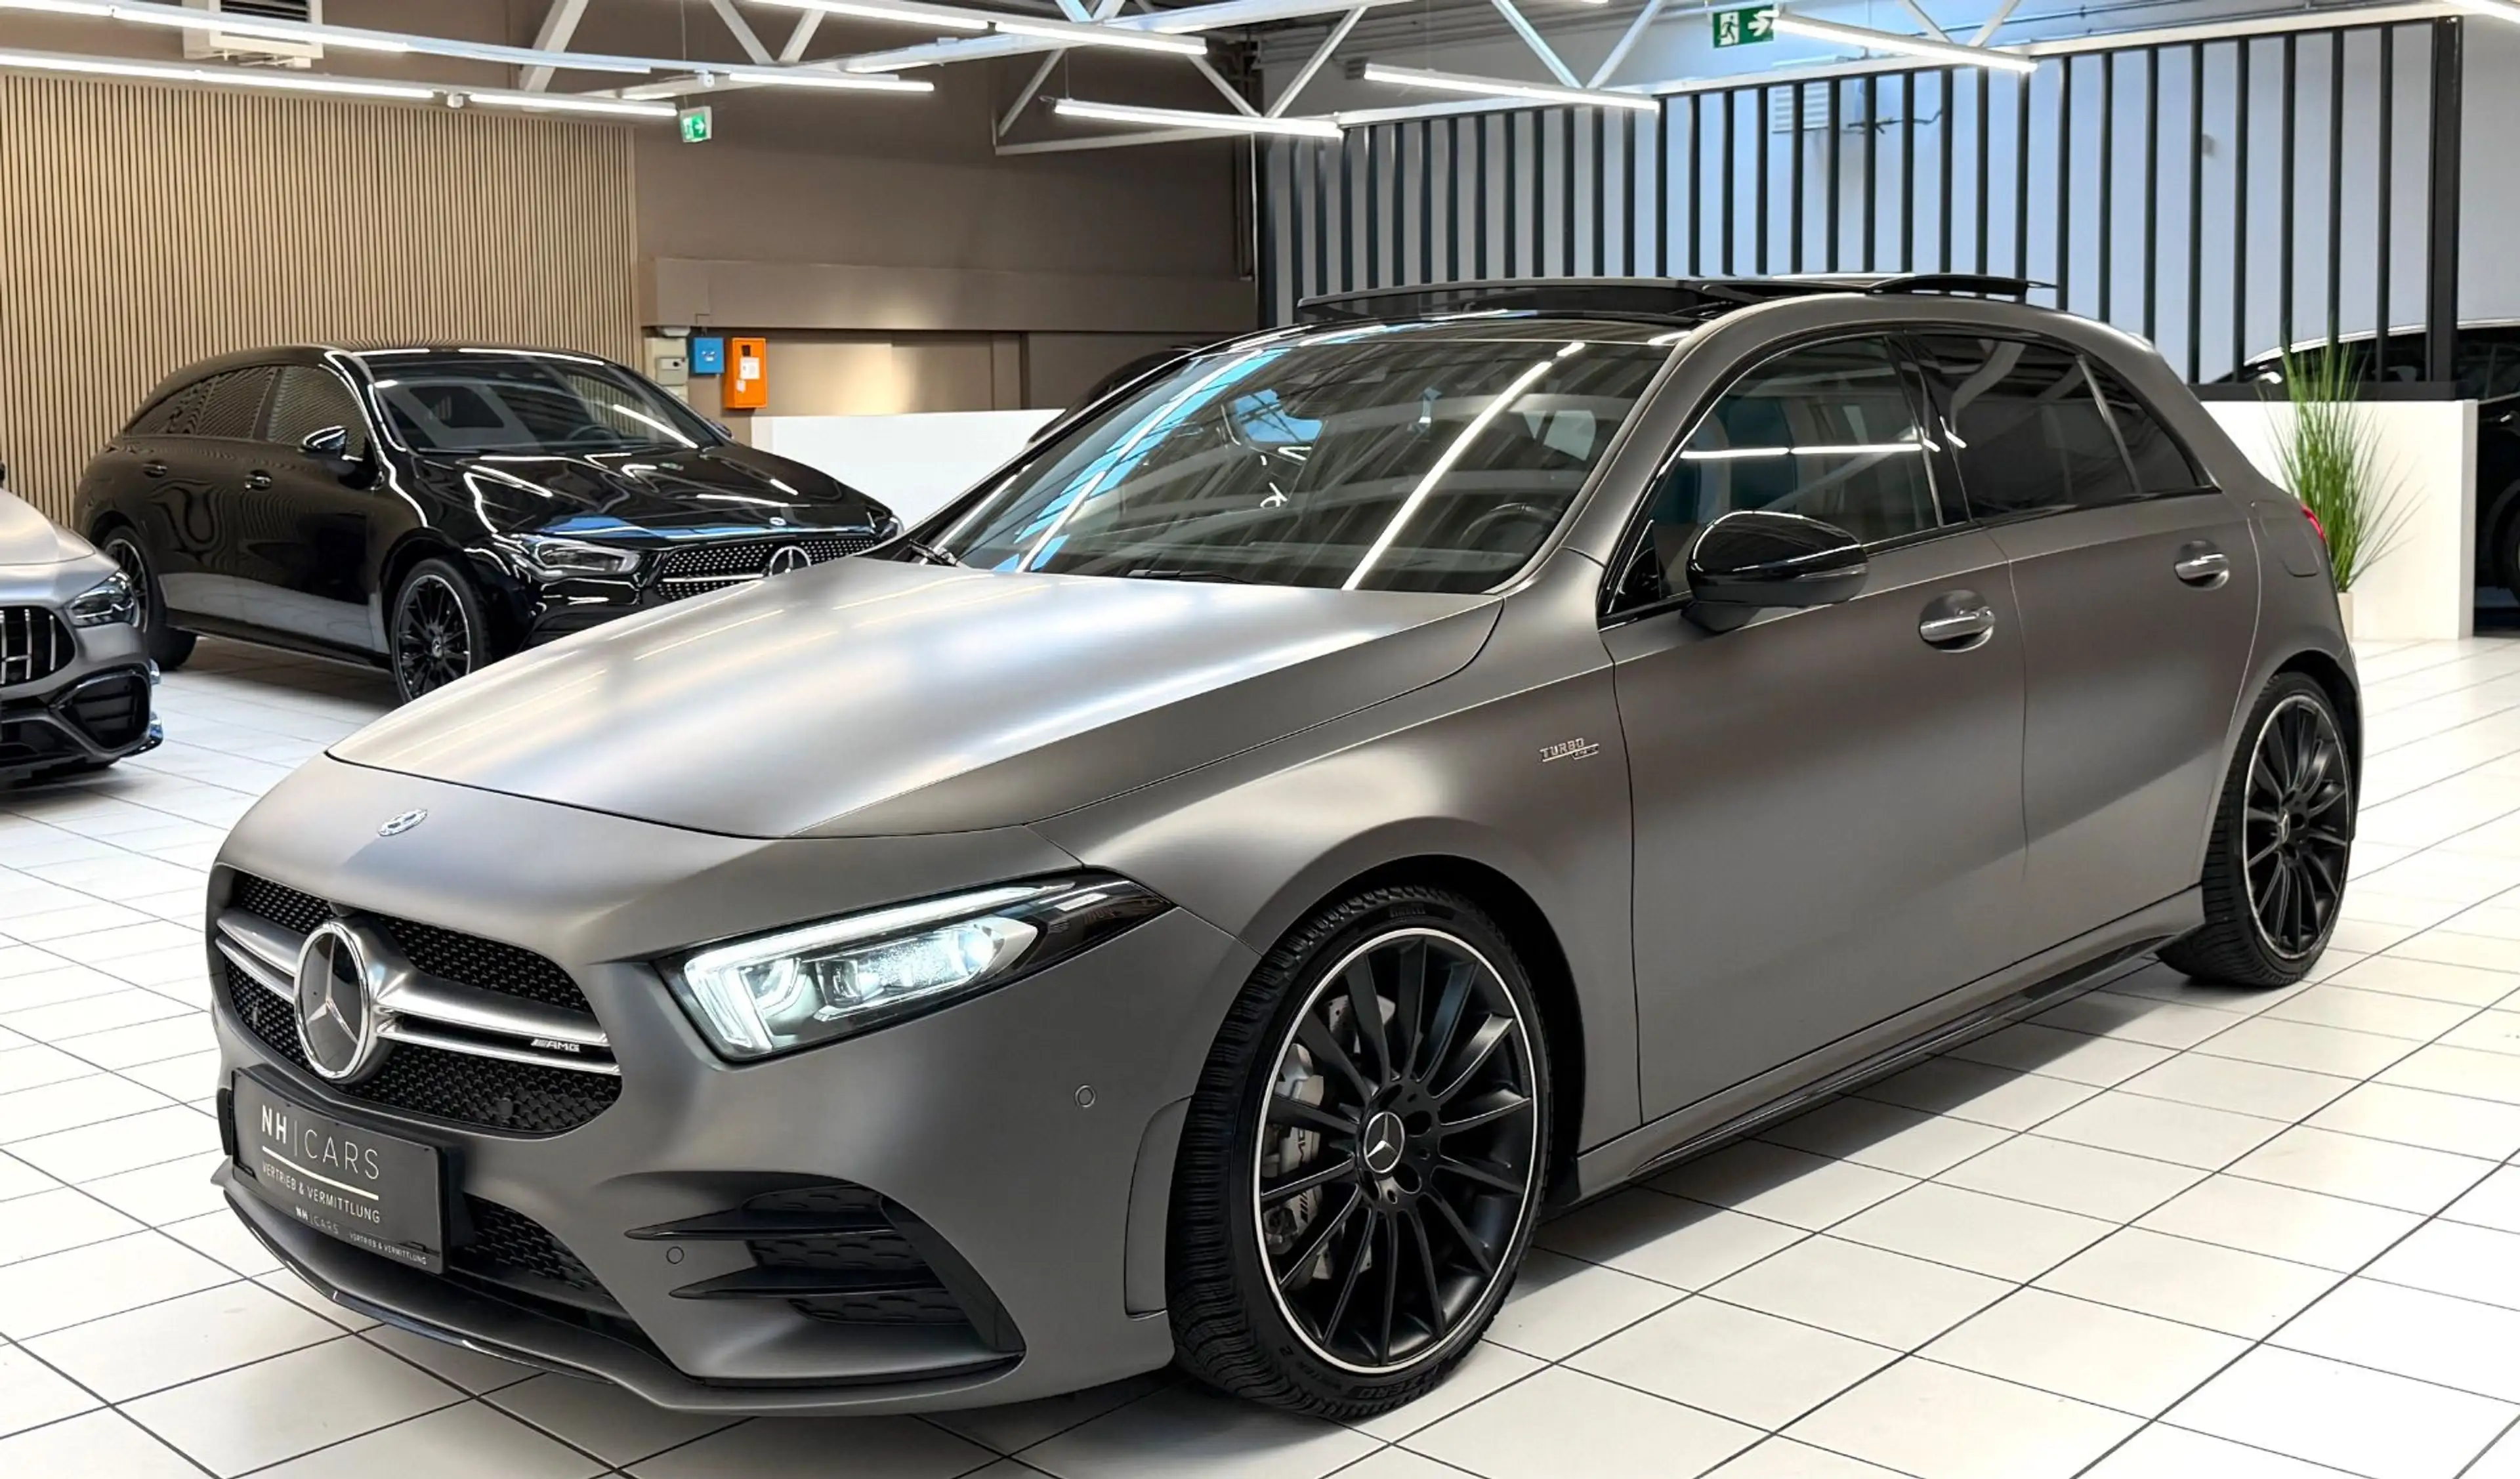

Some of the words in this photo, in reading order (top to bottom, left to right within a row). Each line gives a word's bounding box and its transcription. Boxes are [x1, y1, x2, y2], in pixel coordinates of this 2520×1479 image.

[1540, 738, 1584, 758] TURBO
[545, 1041, 580, 1052] AMG
[262, 1104, 287, 1144] NH
[304, 1129, 379, 1180] CARS
[263, 1160, 297, 1191] VERTRIEB
[299, 1182, 304, 1195] &
[306, 1186, 381, 1223] VERMITTLUNG
